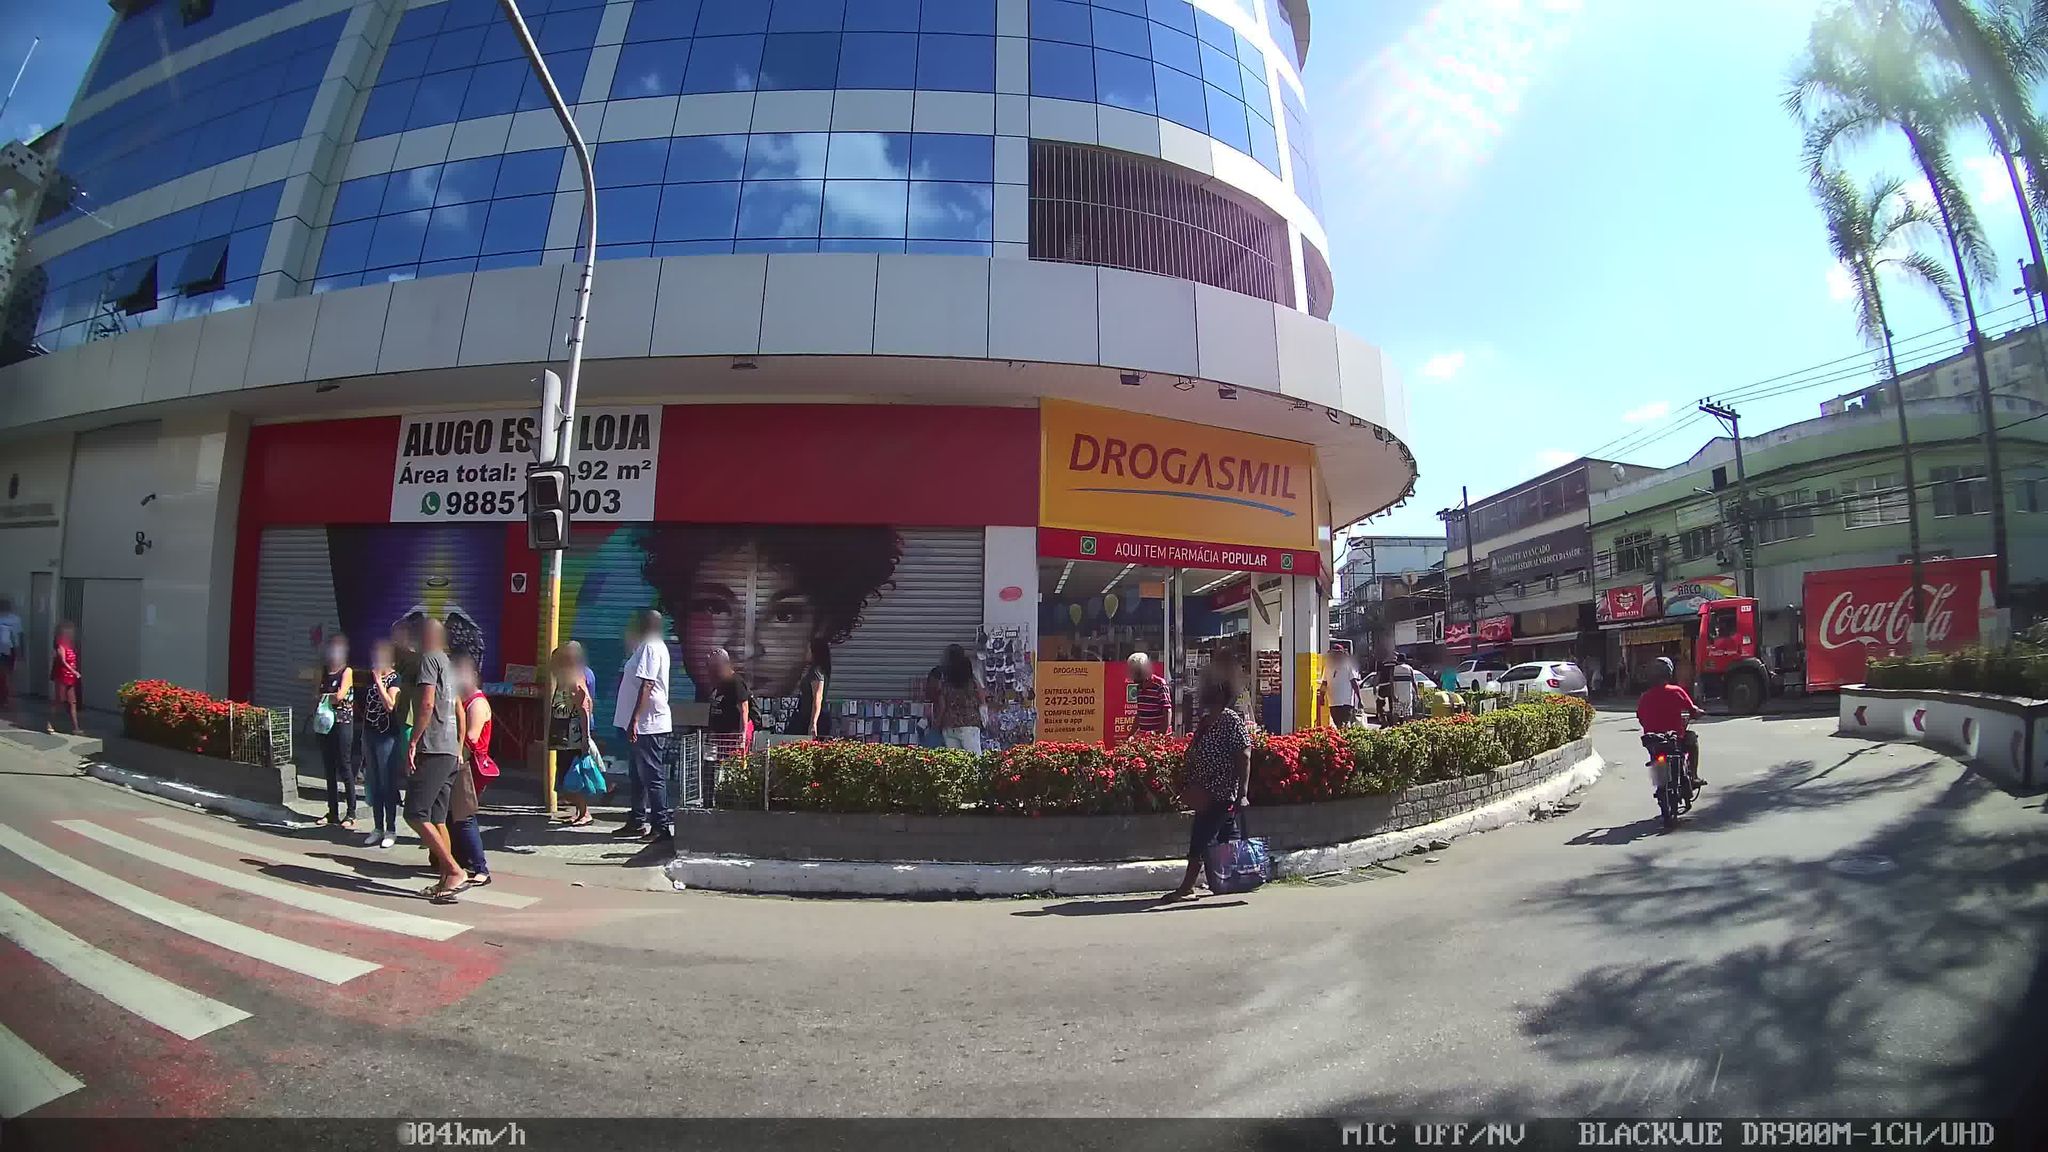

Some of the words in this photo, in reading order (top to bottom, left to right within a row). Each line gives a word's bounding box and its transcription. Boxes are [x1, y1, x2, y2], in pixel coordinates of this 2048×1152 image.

[403, 419, 493, 457] ALUGO
[499, 416, 545, 453] ES
[578, 414, 650, 451] LOJA
[398, 461, 449, 484] Área
[457, 462, 517, 483] total:
[617, 459, 652, 481] m²
[1069, 433, 1297, 499] DROGASMIL
[446, 489, 621, 515] 98851003
[1115, 542, 1141, 558] AQUI
[1144, 544, 1167, 559] TEM
[1169, 546, 1220, 563] FARMÁCIA
[1222, 551, 1267, 567] POPULAR
[1044, 696, 1095, 706] 2472-3000
